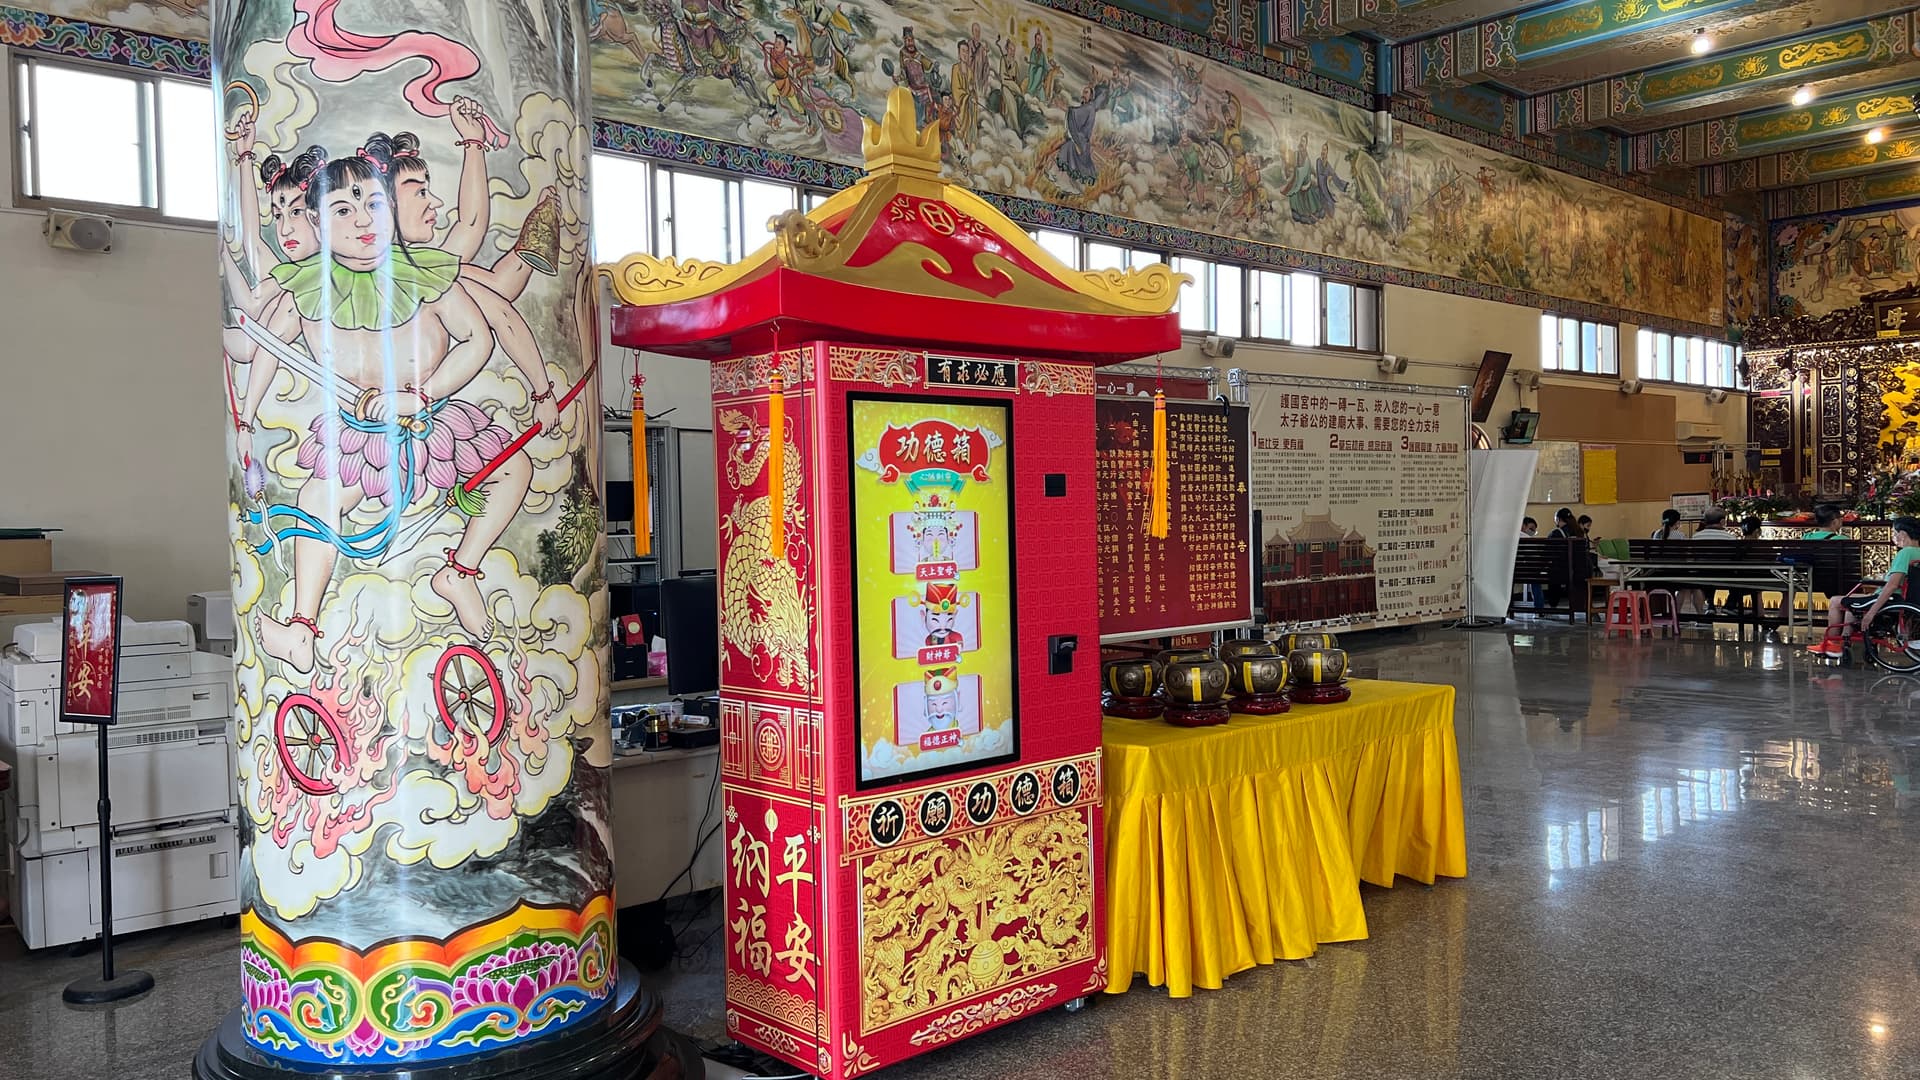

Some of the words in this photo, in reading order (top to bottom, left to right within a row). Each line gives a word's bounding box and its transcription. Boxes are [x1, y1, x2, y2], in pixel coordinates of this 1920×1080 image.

[937, 358, 1008, 386] 有求必應
[896, 430, 971, 464] 功德箱
[920, 565, 954, 578] 天上聖母
[924, 734, 958, 747] 福德正神
[876, 768, 1075, 838] 祈願功德箱
[731, 822, 773, 978] 納福
[776, 834, 821, 992] 平安
